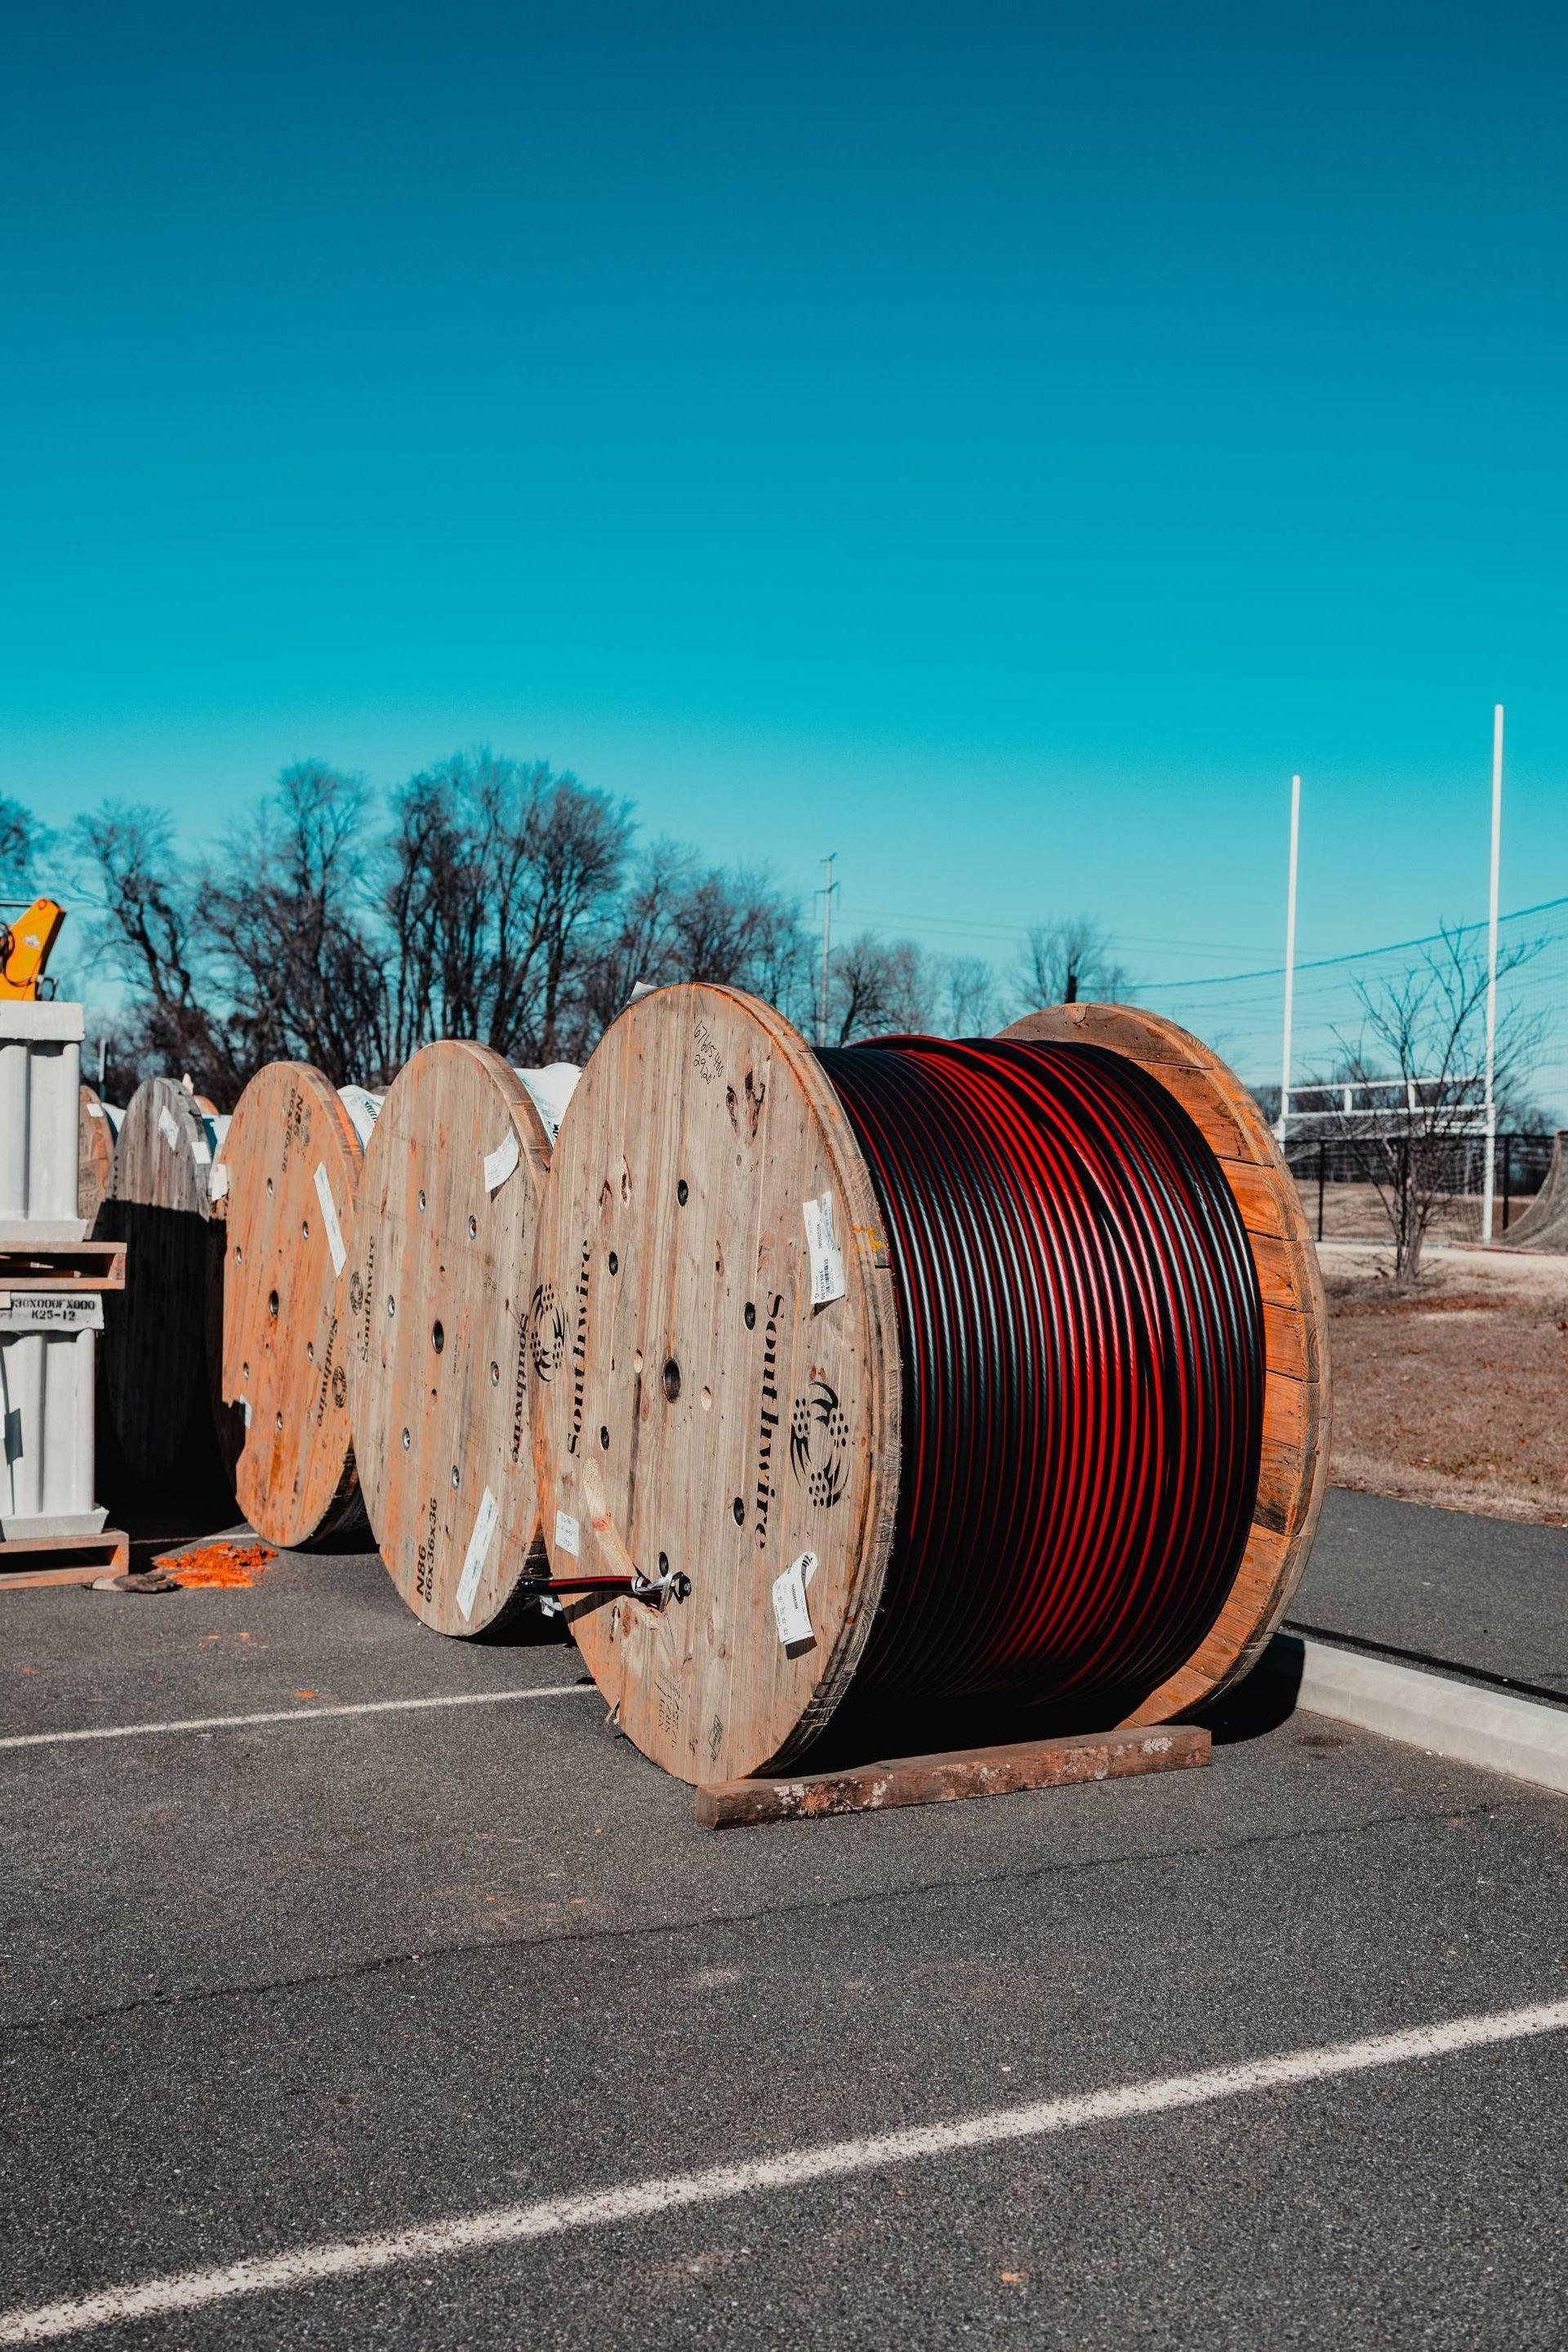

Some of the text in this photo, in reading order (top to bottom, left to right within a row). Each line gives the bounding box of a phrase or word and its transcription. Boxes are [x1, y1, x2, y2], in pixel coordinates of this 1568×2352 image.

[362, 1236, 376, 1363] Southwire
[567, 1239, 590, 1459] Southwire
[317, 1316, 339, 1428] Southwire
[512, 1312, 529, 1463] Southwire
[754, 1290, 785, 1550] Southwire
[416, 1544, 426, 1596] N86
[424, 1497, 438, 1603] 66x36x36
